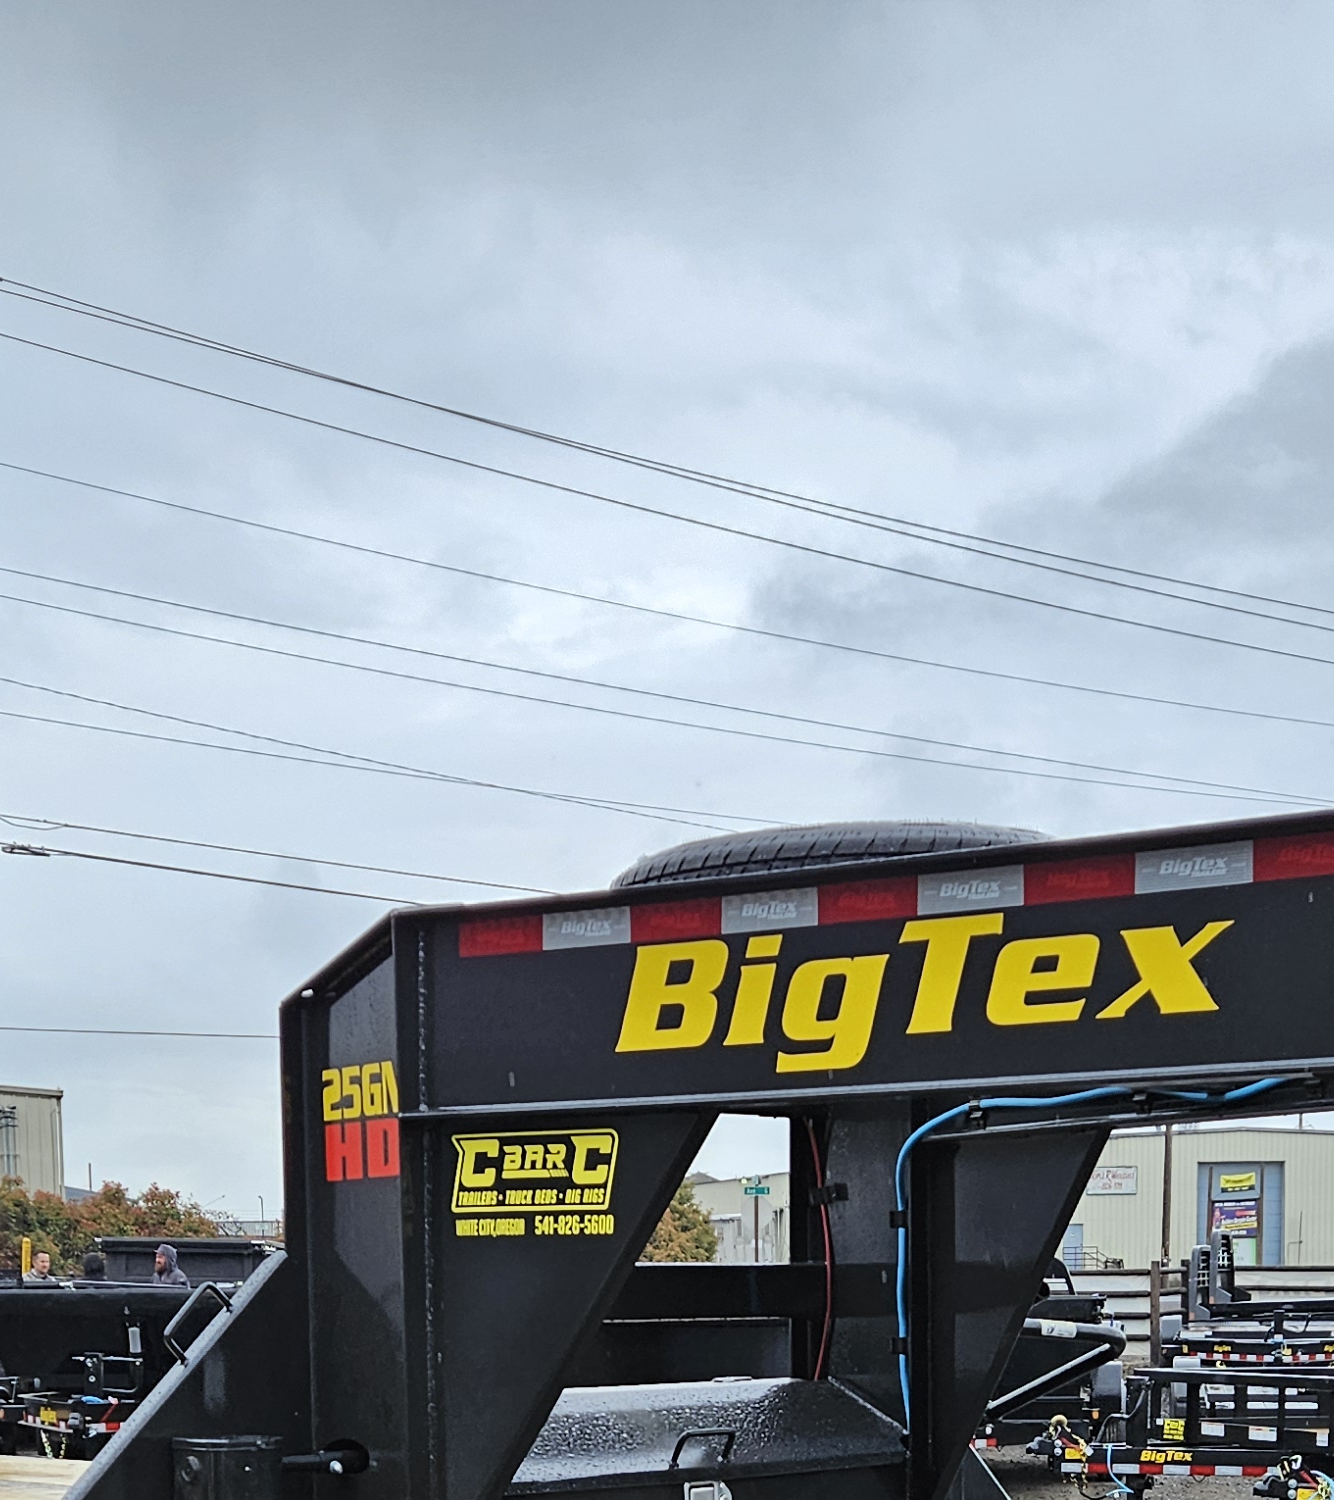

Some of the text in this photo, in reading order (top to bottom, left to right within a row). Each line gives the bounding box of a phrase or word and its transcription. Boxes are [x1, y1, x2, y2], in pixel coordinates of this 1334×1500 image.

[1159, 856, 1229, 876] BigTex
[940, 880, 1001, 899] BigTex
[741, 901, 797, 919] BigTex
[560, 918, 612, 936] BigTex
[615, 912, 1234, 1074] BigTex
[325, 1117, 401, 1182] HD
[459, 1138, 500, 1188] C
[570, 1134, 613, 1185] C
[458, 1188, 605, 1206] TRAILERS TRUCK BEDS BIG RIGS
[455, 1218, 479, 1237] WHITE
[534, 1214, 615, 1236] 541-826-5600
[1140, 1450, 1193, 1464] BigTex
